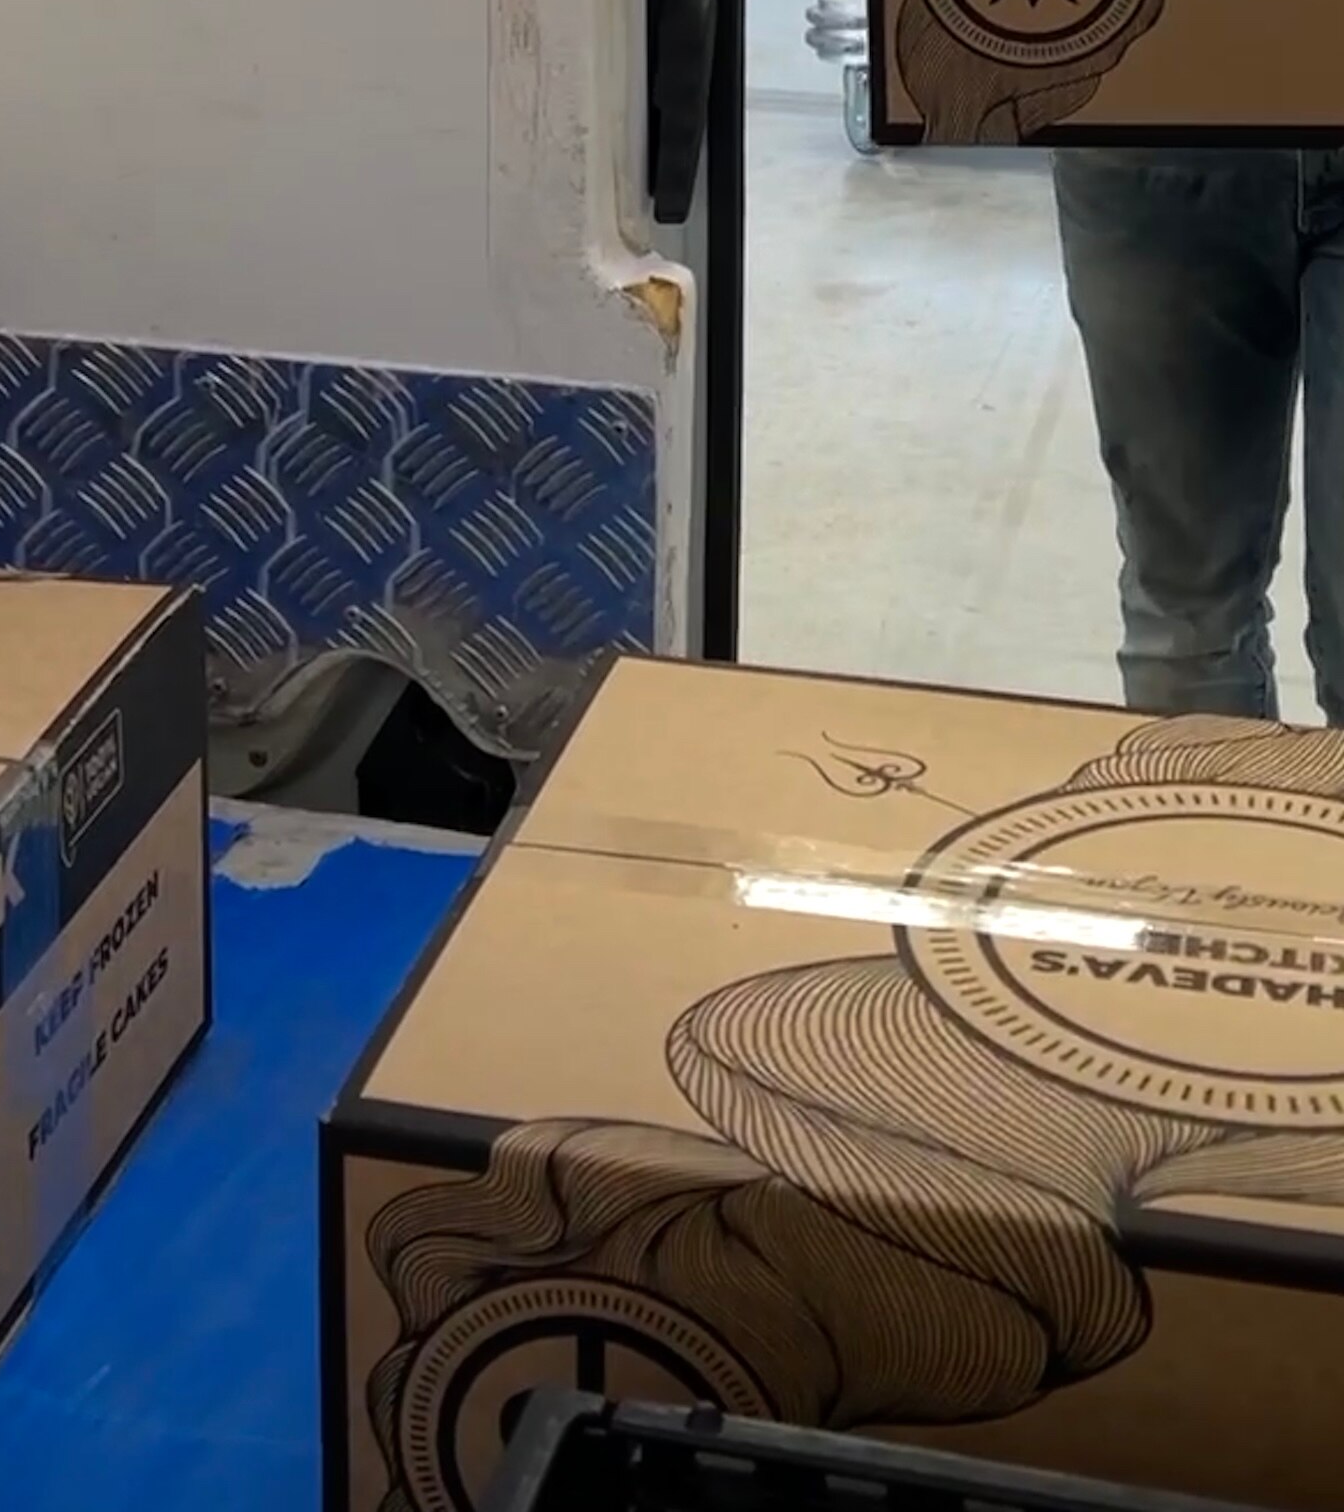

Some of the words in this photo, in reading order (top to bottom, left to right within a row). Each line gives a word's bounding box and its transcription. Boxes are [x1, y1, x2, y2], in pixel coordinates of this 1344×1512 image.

[27, 1029, 107, 1162] FRAGILE
[111, 946, 170, 1043] CAKES
[34, 971, 84, 1057] KEEP
[88, 869, 160, 986] FROZEN
